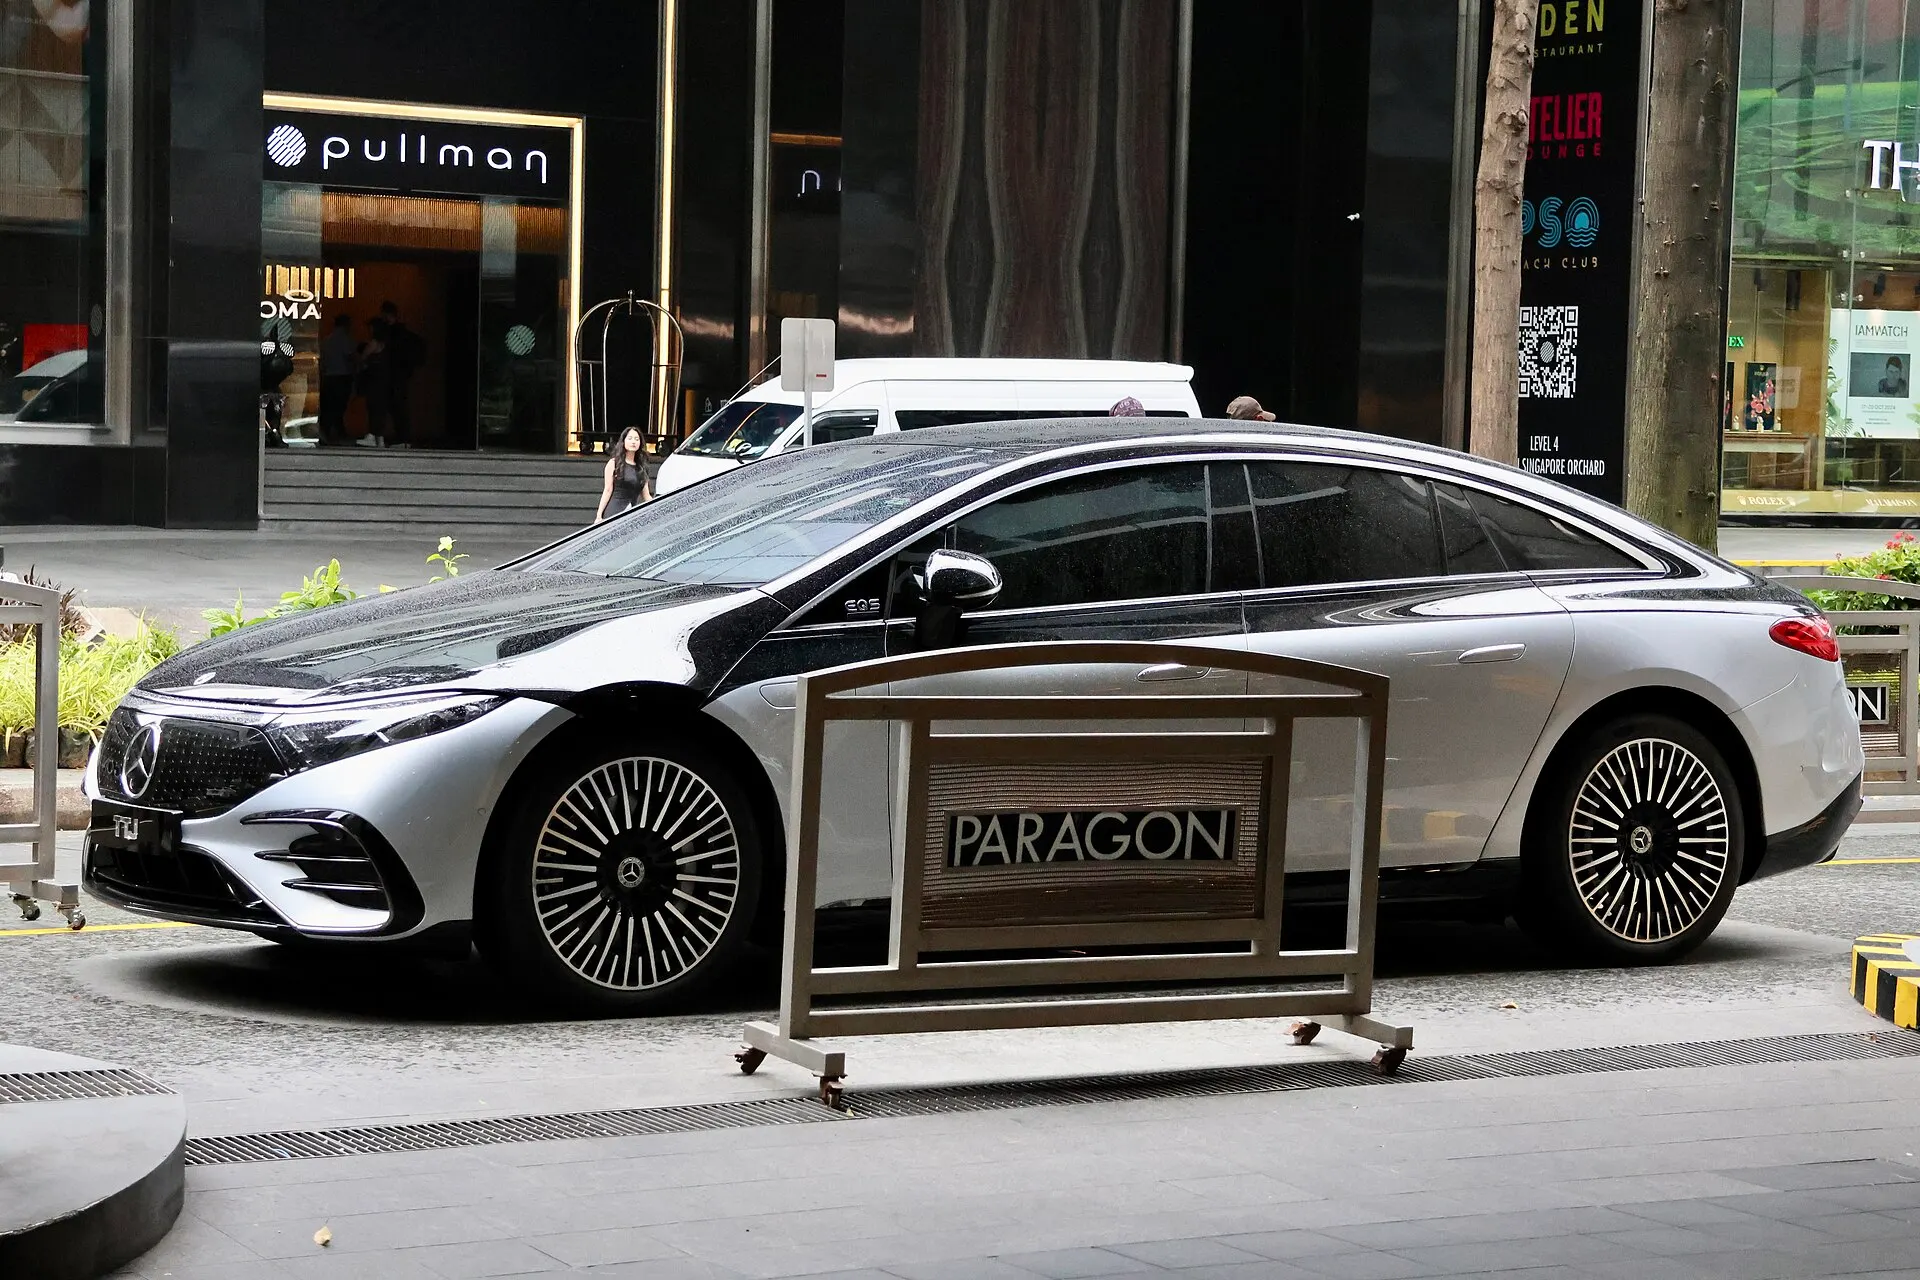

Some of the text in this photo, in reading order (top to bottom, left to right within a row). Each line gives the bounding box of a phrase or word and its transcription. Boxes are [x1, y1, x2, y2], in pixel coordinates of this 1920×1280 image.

[1541, 0, 1604, 37] DEN
[1534, 43, 1603, 58] STAURANT
[1529, 92, 1602, 143] TELIER
[323, 133, 547, 184] pullman
[1527, 143, 1601, 160] OUNGE
[1863, 140, 1920, 190] TH
[1522, 196, 1600, 248] PSO
[1523, 256, 1598, 270] ACH CLUB
[1855, 325, 1908, 337] IAMWATCH
[1729, 336, 1744, 347] EX
[1530, 436, 1559, 451] LEVEL 4
[1522, 458, 1605, 476] SINGAPORE ORCHARD
[1749, 496, 1785, 505] ROLEX
[845, 598, 880, 611] EQS
[953, 809, 1228, 867] PARAGON
